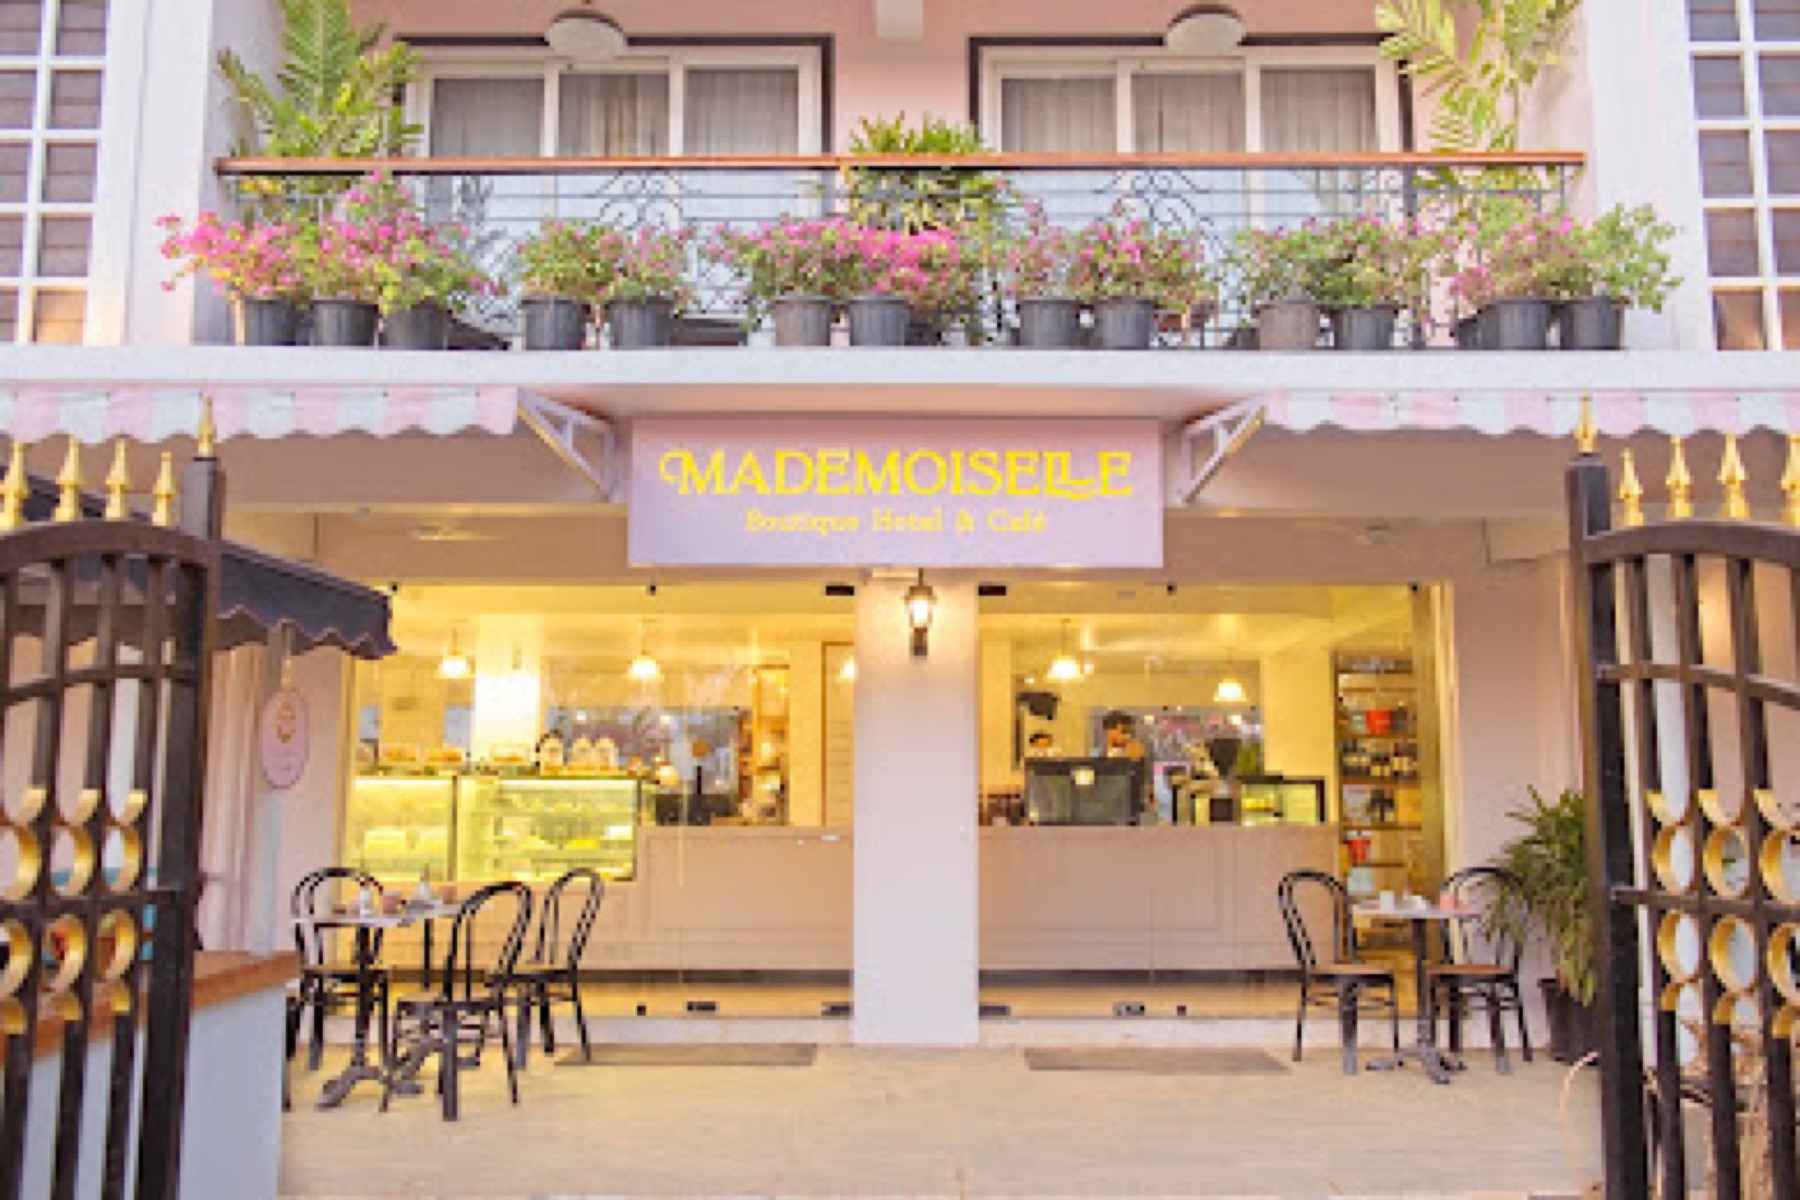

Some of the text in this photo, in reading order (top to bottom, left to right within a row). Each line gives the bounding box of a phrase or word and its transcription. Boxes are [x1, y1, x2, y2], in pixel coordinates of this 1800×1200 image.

[659, 449, 1132, 499] MADEMOISELLE
[746, 507, 1047, 535] Boutique Hotel & Café
